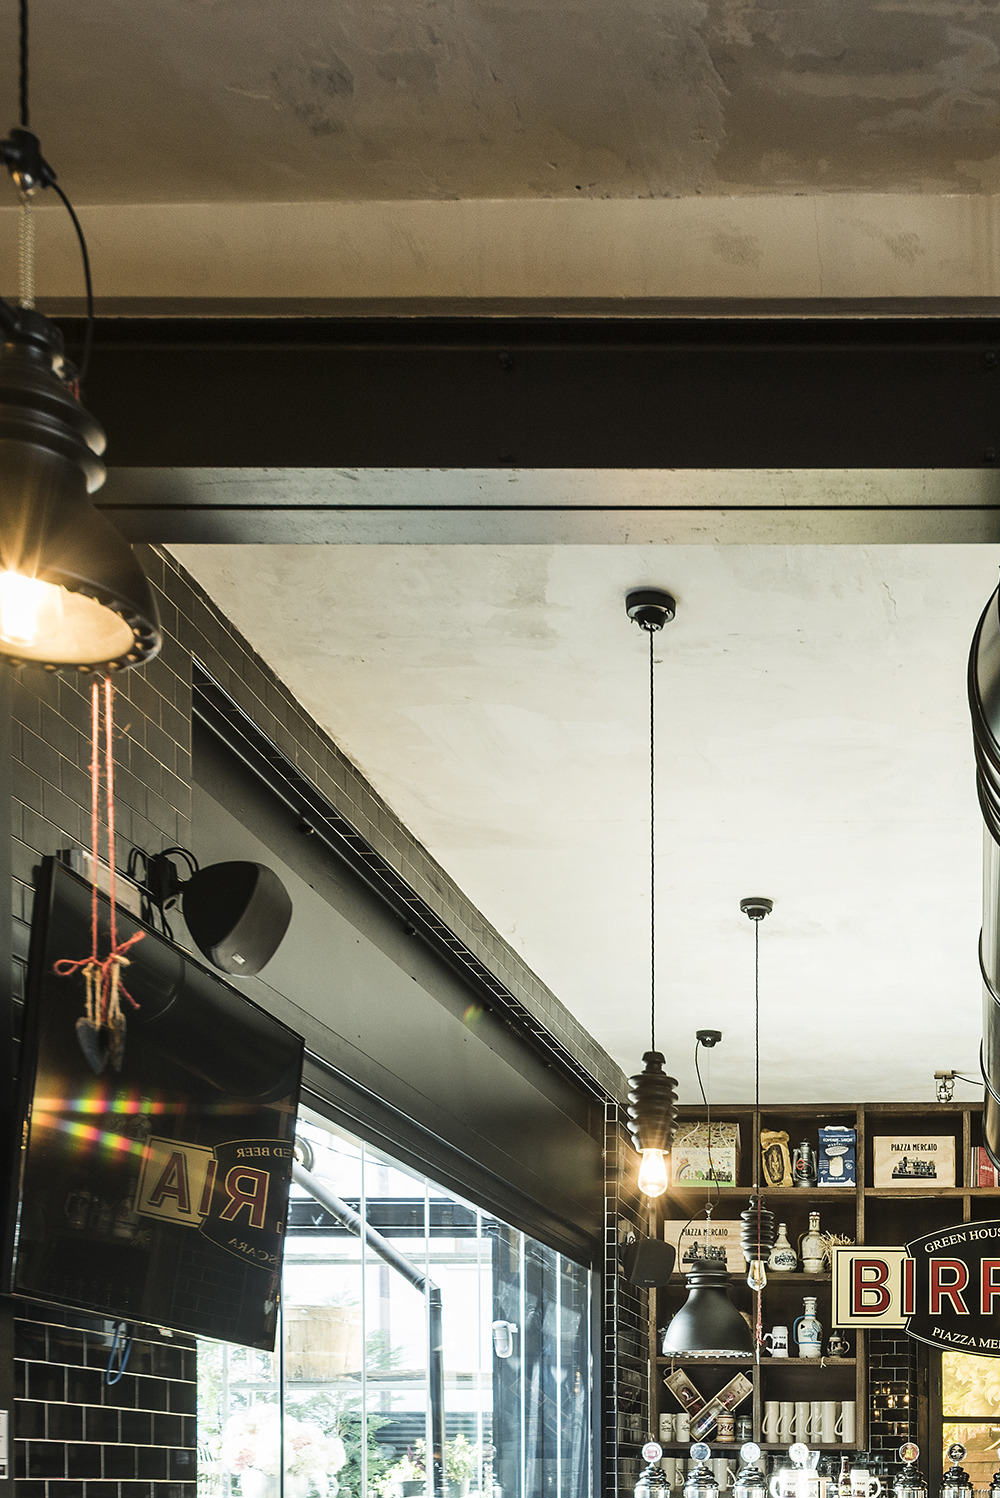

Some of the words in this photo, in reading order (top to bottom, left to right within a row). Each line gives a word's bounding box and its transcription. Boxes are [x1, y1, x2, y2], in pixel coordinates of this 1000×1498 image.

[890, 1143, 911, 1152] PIAZZA
[912, 1143, 938, 1152] MERCATO
[924, 1235, 968, 1254] GREEN
[932, 1327, 977, 1347] PIAZZA
